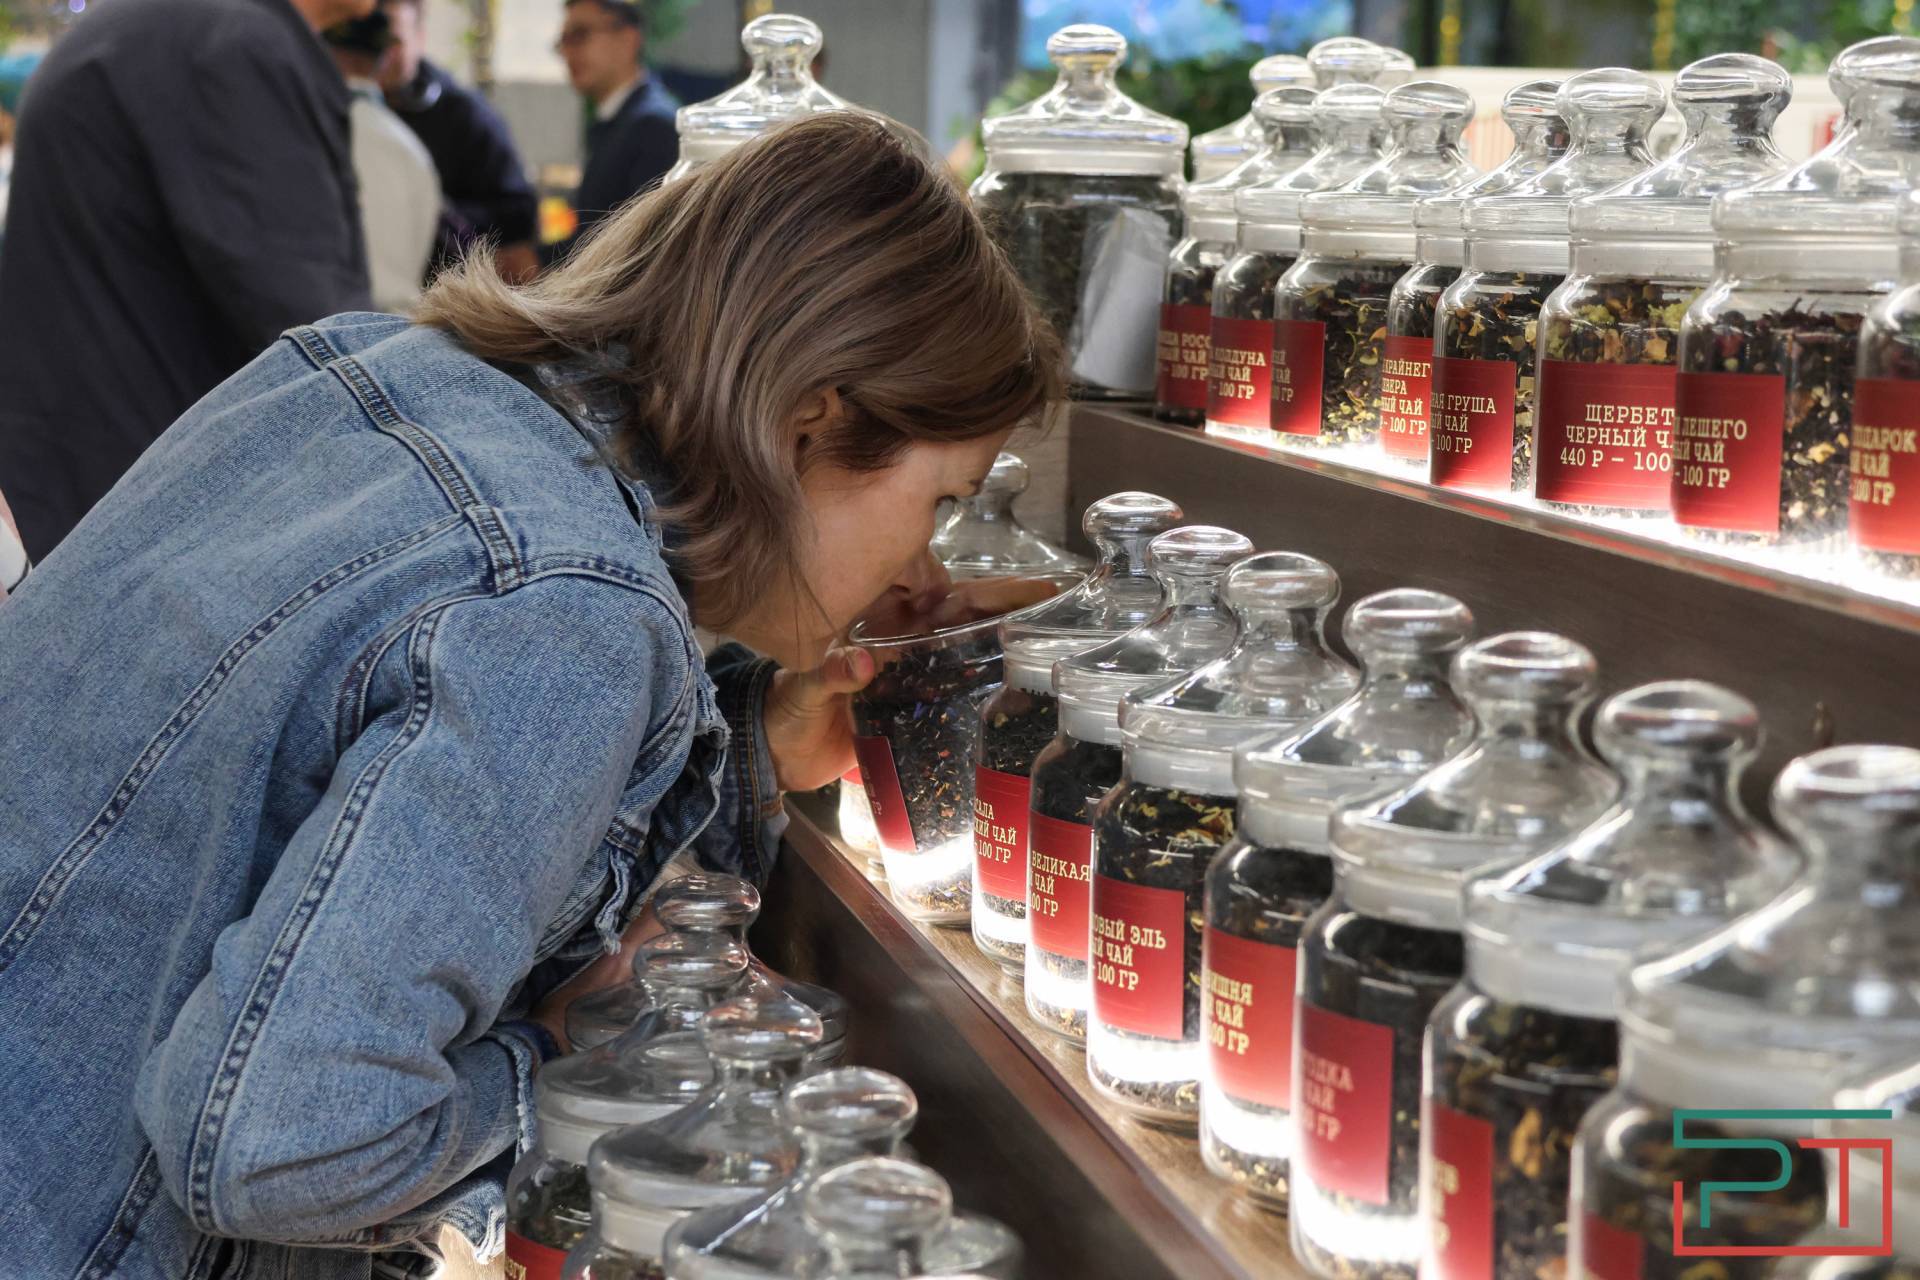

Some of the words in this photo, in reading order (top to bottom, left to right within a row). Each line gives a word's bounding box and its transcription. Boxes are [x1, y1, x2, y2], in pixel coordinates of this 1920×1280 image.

[1182, 349, 1206, 364] ЧАЙ
[1191, 366, 1209, 380] ГР
[1228, 366, 1251, 382] ЧАЙ
[1383, 359, 1432, 378] КРАЙНЕГ
[1218, 382, 1234, 397] 100
[1238, 385, 1255, 399] ГР
[1399, 398, 1423, 415] ЧАЙ
[1448, 394, 1497, 414] ГРУША
[1390, 417, 1406, 433] 100
[1409, 420, 1427, 435] ГР
[1445, 414, 1468, 432] ЧАЙ
[1682, 416, 1748, 440] ЛЕШЕГО
[1437, 434, 1452, 452] 100
[1455, 437, 1473, 454] ГР
[1566, 425, 1647, 448] ЧЕРНЫЙ
[1656, 430, 1674, 449] Ч
[1560, 447, 1586, 466] 440
[1592, 450, 1604, 468] Р
[1633, 452, 1671, 472] 100
[1694, 441, 1724, 463] ЧАЙ
[1863, 452, 1889, 478] ЧАЙ
[1683, 466, 1703, 486] 100
[1707, 468, 1731, 488] ГР
[1872, 481, 1895, 506] ГР
[992, 825, 1017, 846] ЧАЙ
[978, 839, 992, 859] 100
[995, 846, 1012, 864] ГР
[1032, 850, 1091, 882] ВЕЛИКАЯ
[1034, 873, 1055, 896] ЧАЙ
[1030, 893, 1041, 912] 00
[1043, 898, 1059, 917] ГР
[1130, 925, 1167, 949] ЭЛЬ
[1106, 942, 1133, 967] ЧАЙ
[1097, 962, 1115, 985] 100
[1118, 969, 1139, 991] ГР
[1216, 1000, 1244, 1029] ЧАЙ
[1228, 1029, 1249, 1055] ГР
